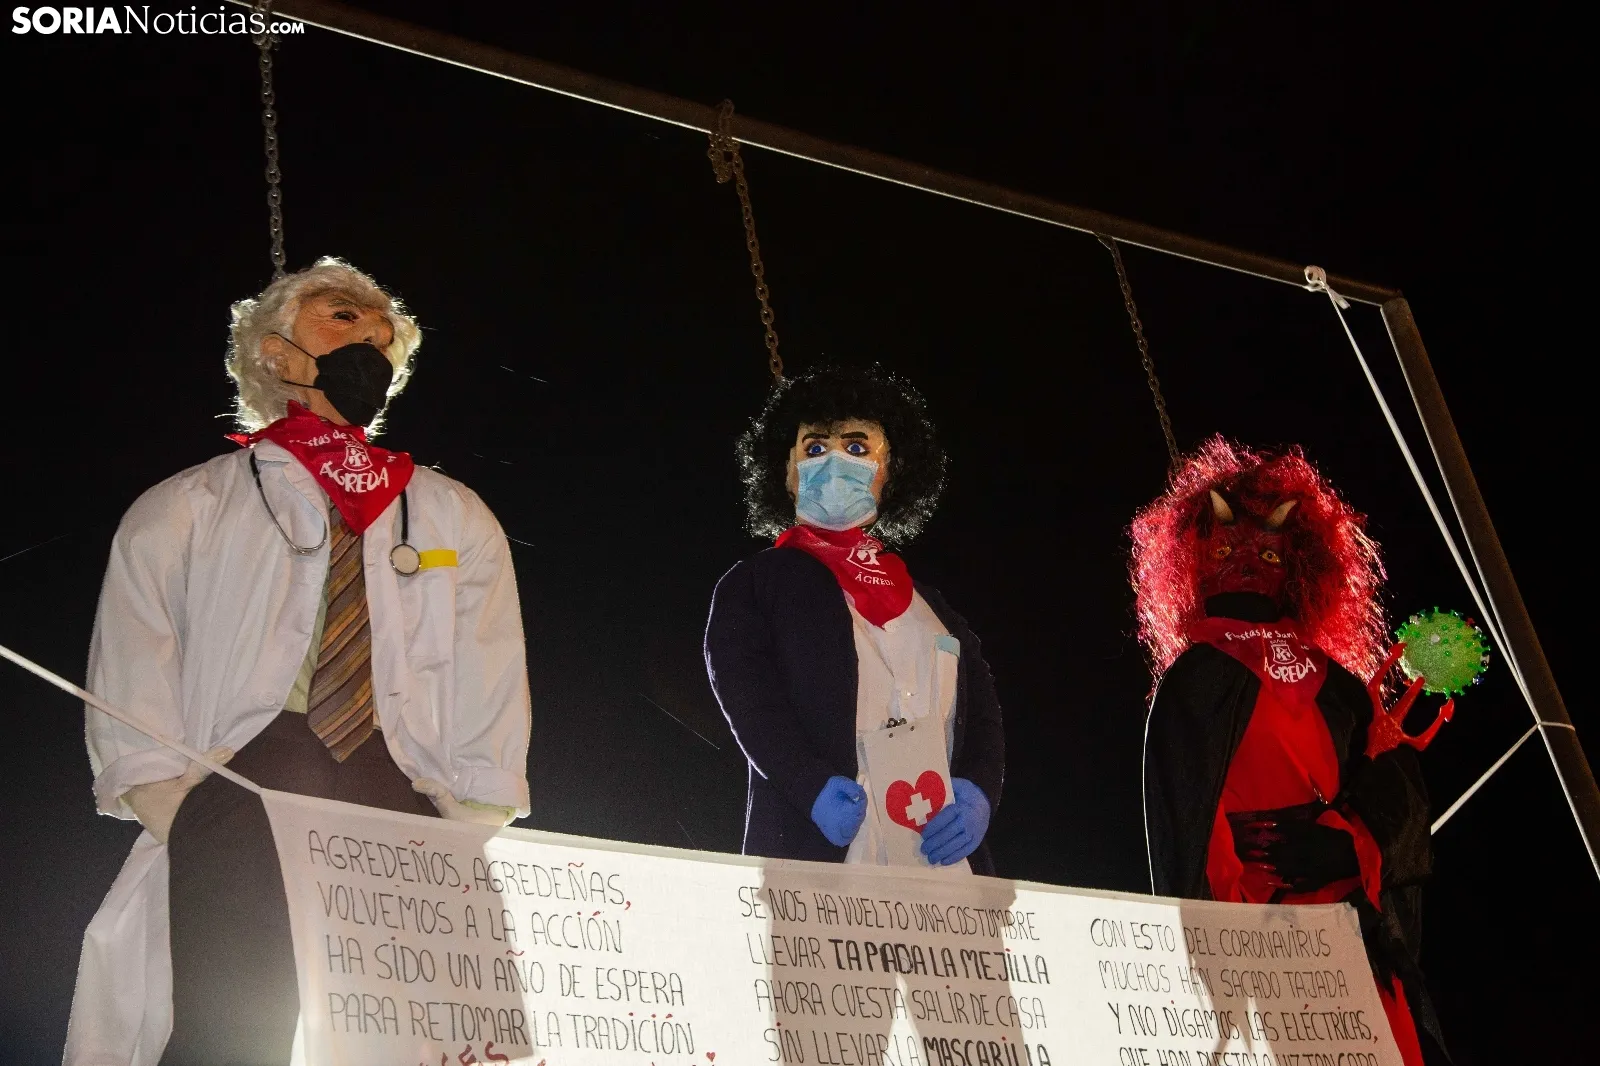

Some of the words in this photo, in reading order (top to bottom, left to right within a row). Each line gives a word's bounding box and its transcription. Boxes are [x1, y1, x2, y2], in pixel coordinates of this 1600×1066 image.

[308, 830, 470, 894] AGREDEÑOS,
[472, 857, 632, 911] AGREDEÑAS,
[317, 880, 454, 935] VOLVEMOS
[465, 904, 480, 939] A
[488, 908, 517, 943] LA
[531, 910, 623, 954] ACCIÓN
[738, 886, 767, 919] SE
[768, 888, 808, 923] NOS
[813, 892, 838, 927] HA
[838, 895, 909, 931] VUELTO
[910, 903, 946, 935] UNA
[946, 905, 1040, 942] COSTUMBRE
[1090, 918, 1127, 948] CON
[1130, 921, 1176, 952] ESTO
[1183, 927, 1216, 955] DEL
[326, 934, 366, 976] HA
[374, 936, 436, 984] SIDO
[447, 952, 482, 991] UN
[494, 949, 546, 994] AÑO
[559, 962, 586, 999] DE
[595, 967, 685, 1007] ESPERA
[746, 933, 827, 969] LLEVAR
[959, 947, 1051, 985] MEJILLA
[1098, 960, 1171, 993] MUCHOS
[1178, 965, 1215, 997] HAN
[1220, 968, 1281, 999] SACADO
[1283, 969, 1350, 998] TAJADA
[327, 992, 399, 1036] PARA
[408, 1000, 528, 1046] RETOMAR
[532, 1010, 563, 1048] LA
[566, 1011, 696, 1056] TRADICIÓN
[754, 978, 827, 1017] AHORA
[831, 984, 907, 1020] CUESTA
[911, 984, 966, 1025] SALIR
[969, 993, 995, 1027] DE
[995, 995, 1048, 1029] CASA
[1107, 1002, 1122, 1035] Y
[1128, 1004, 1158, 1037] NO
[1162, 1000, 1240, 1040] DIGAMOS
[1244, 1010, 1280, 1041] LAS
[1281, 1003, 1379, 1044] ELÉCTRICAS,
[764, 1022, 805, 1064] SIN
[811, 1030, 894, 1066] LLEVAR
